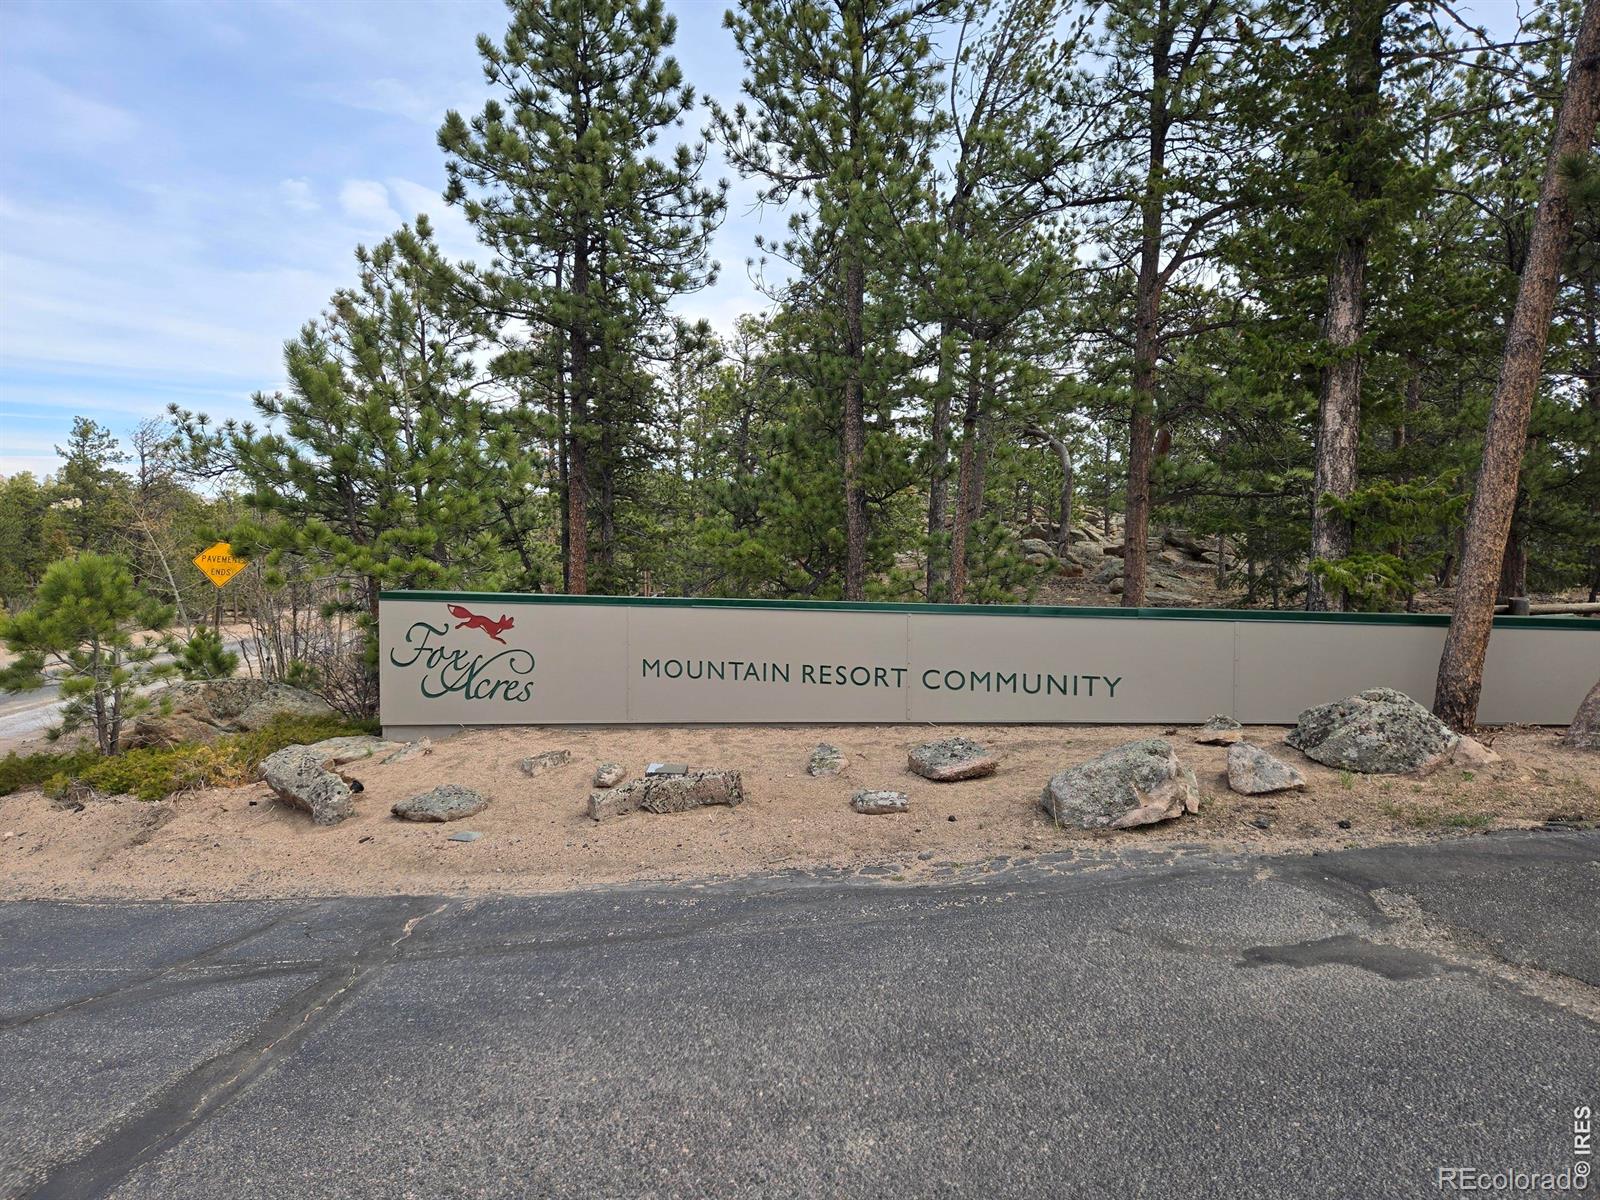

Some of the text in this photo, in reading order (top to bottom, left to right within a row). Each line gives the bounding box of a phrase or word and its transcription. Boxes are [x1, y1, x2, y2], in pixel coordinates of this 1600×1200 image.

[211, 568, 232, 576] ENDS
[390, 622, 470, 671] Fox
[420, 649, 535, 702] Acres
[642, 659, 1122, 698] MOUNTAIN RESORT COMMUNITY
